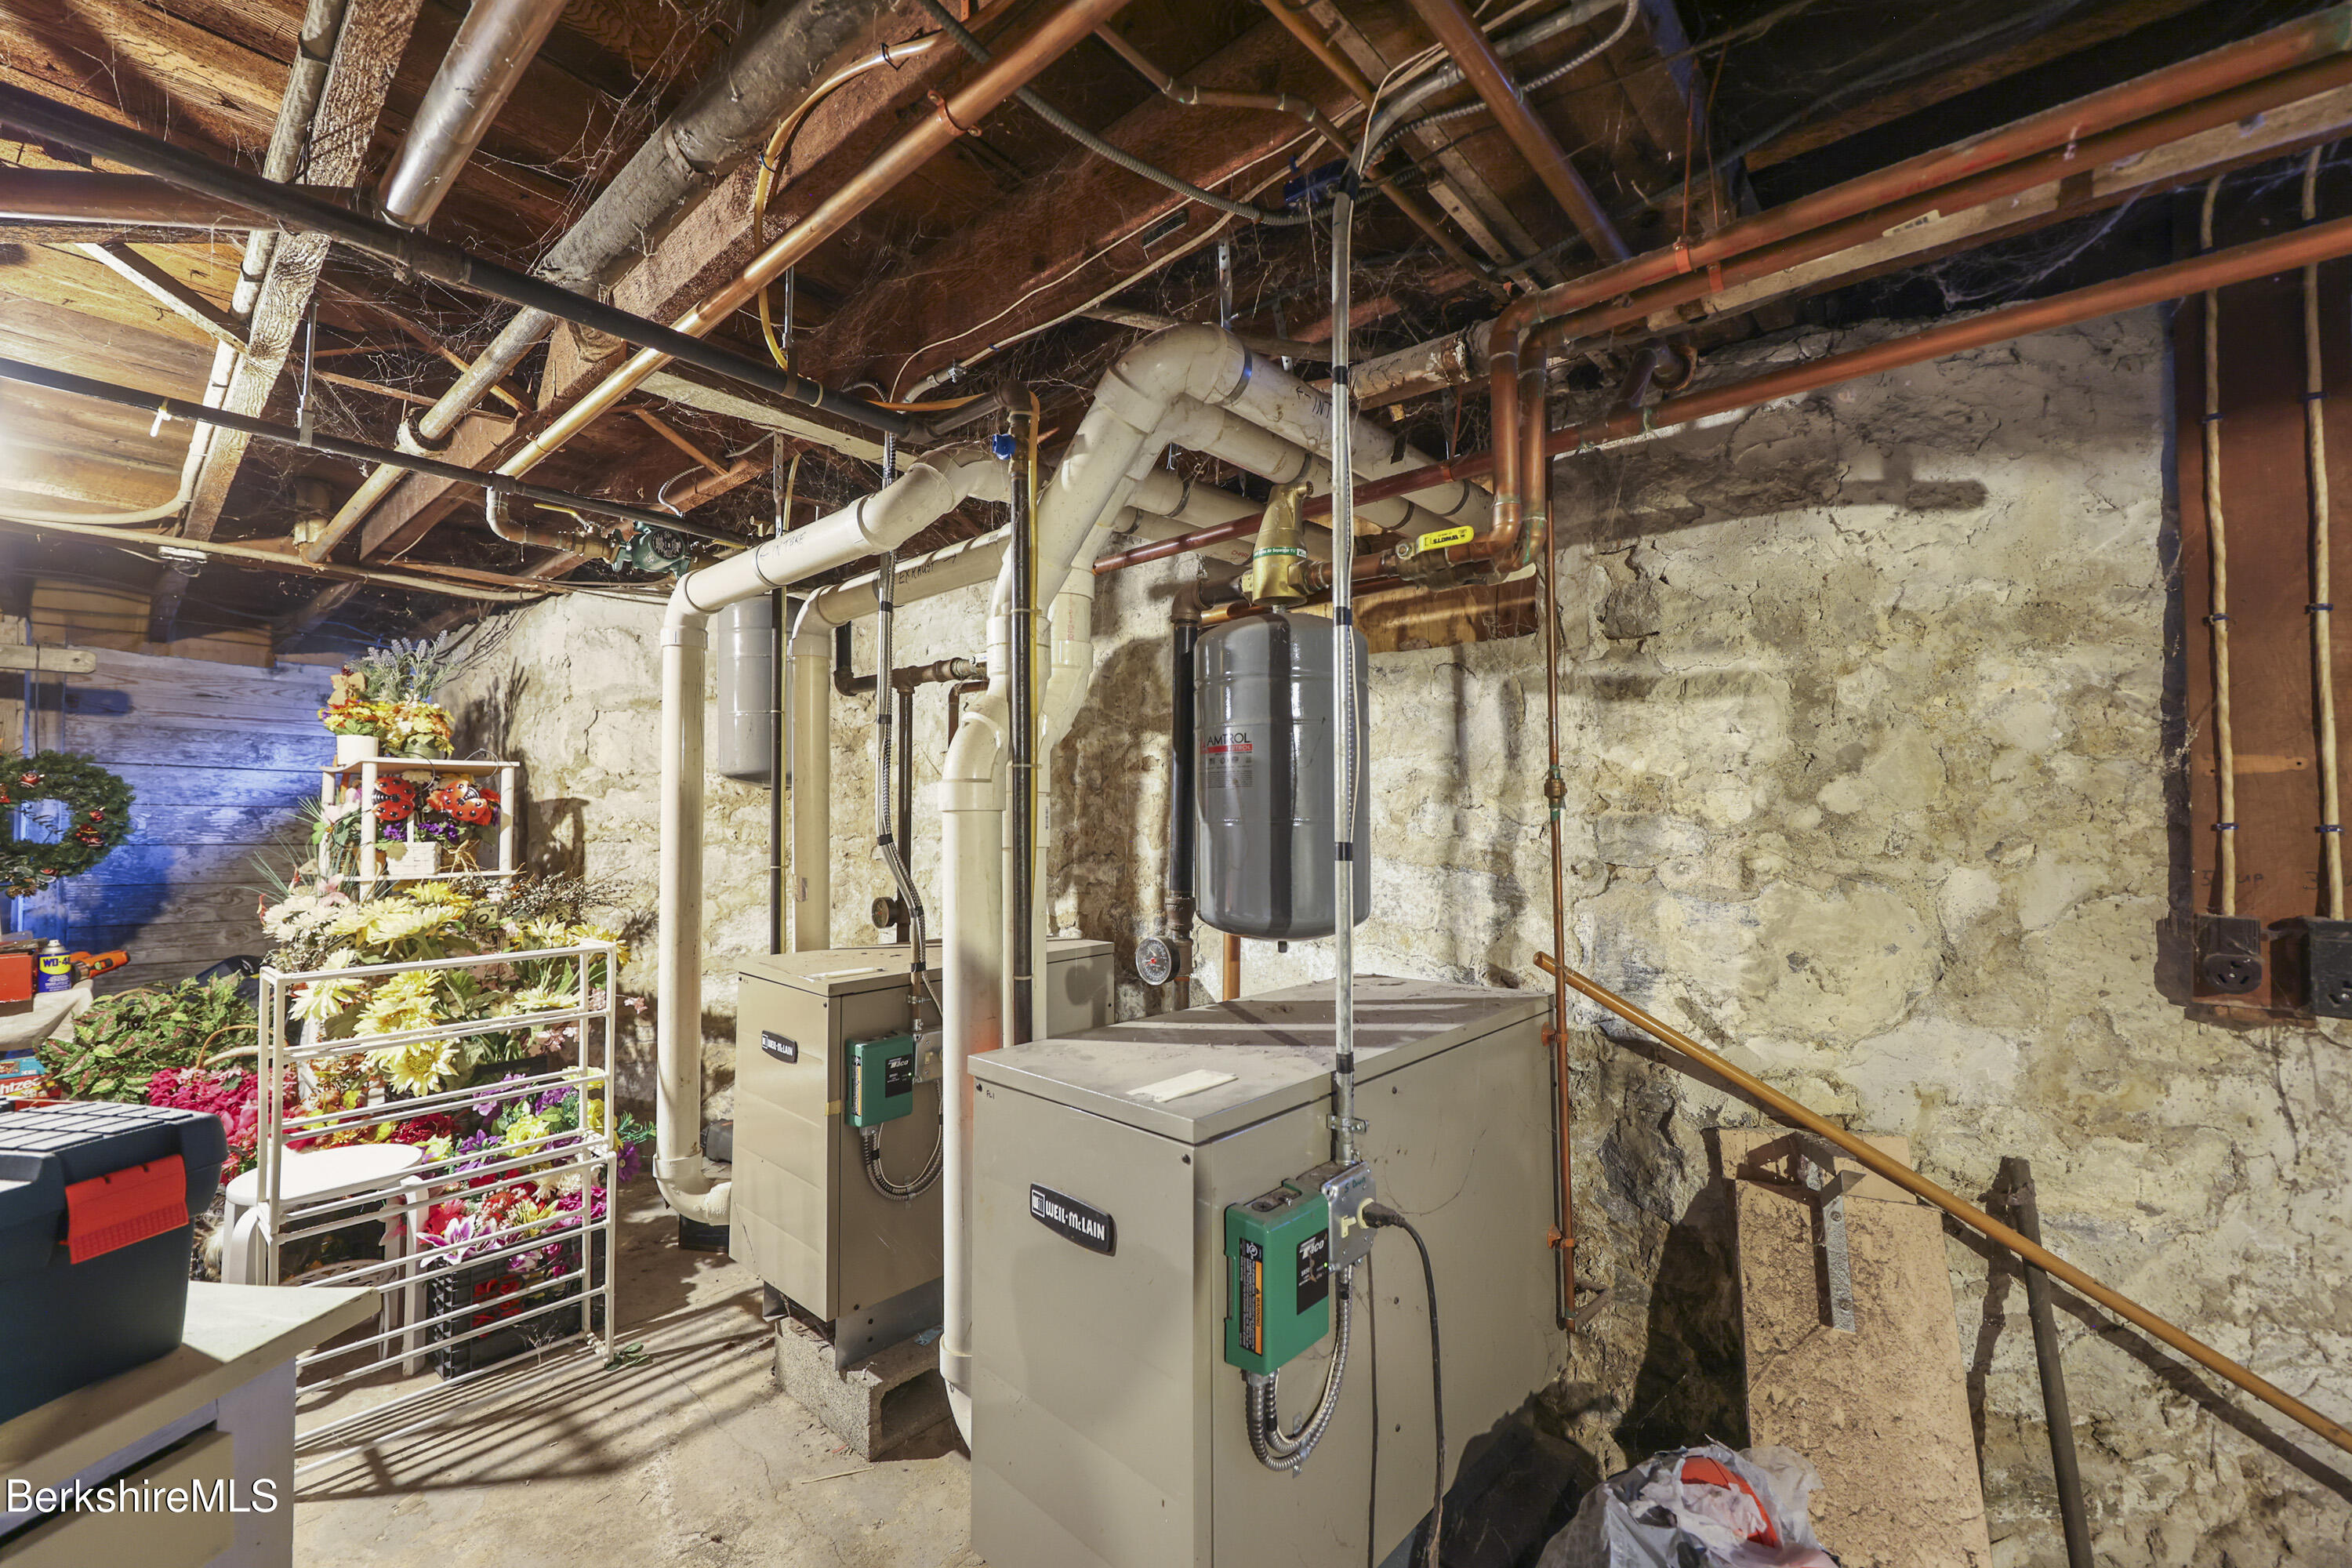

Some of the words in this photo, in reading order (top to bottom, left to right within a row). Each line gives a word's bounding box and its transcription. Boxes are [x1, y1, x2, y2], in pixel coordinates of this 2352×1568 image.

[1312, 397, 1332, 419] INT
[1432, 535, 1459, 545] WATTS
[1207, 732, 1250, 746] AMTROL
[42, 956, 70, 967] WD-4
